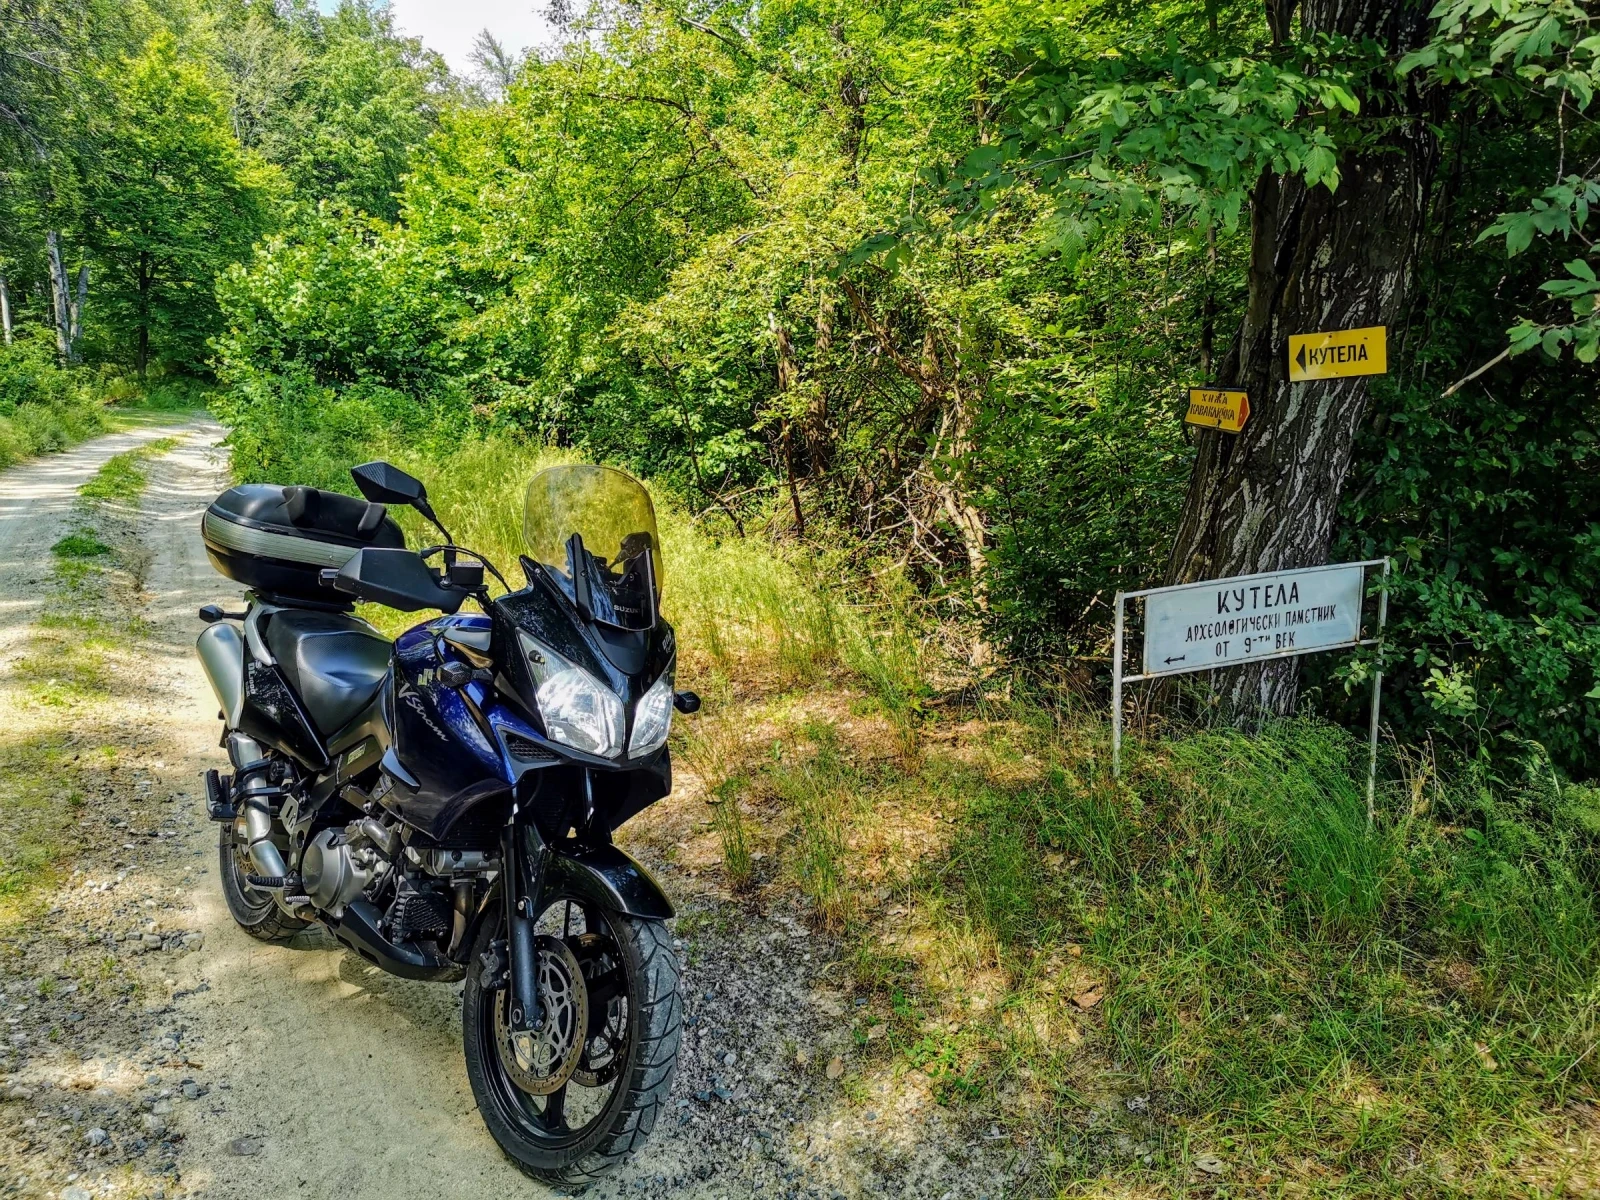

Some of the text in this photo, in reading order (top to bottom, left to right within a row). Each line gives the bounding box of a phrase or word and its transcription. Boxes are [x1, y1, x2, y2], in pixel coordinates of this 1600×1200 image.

[1309, 344, 1368, 365] КУТЕЛА
[1217, 582, 1300, 614] КУТЕЛА
[1284, 604, 1337, 627] ПАМЕТНИК
[1215, 641, 1231, 657] ОТ
[1275, 632, 1296, 650] ВЕК
